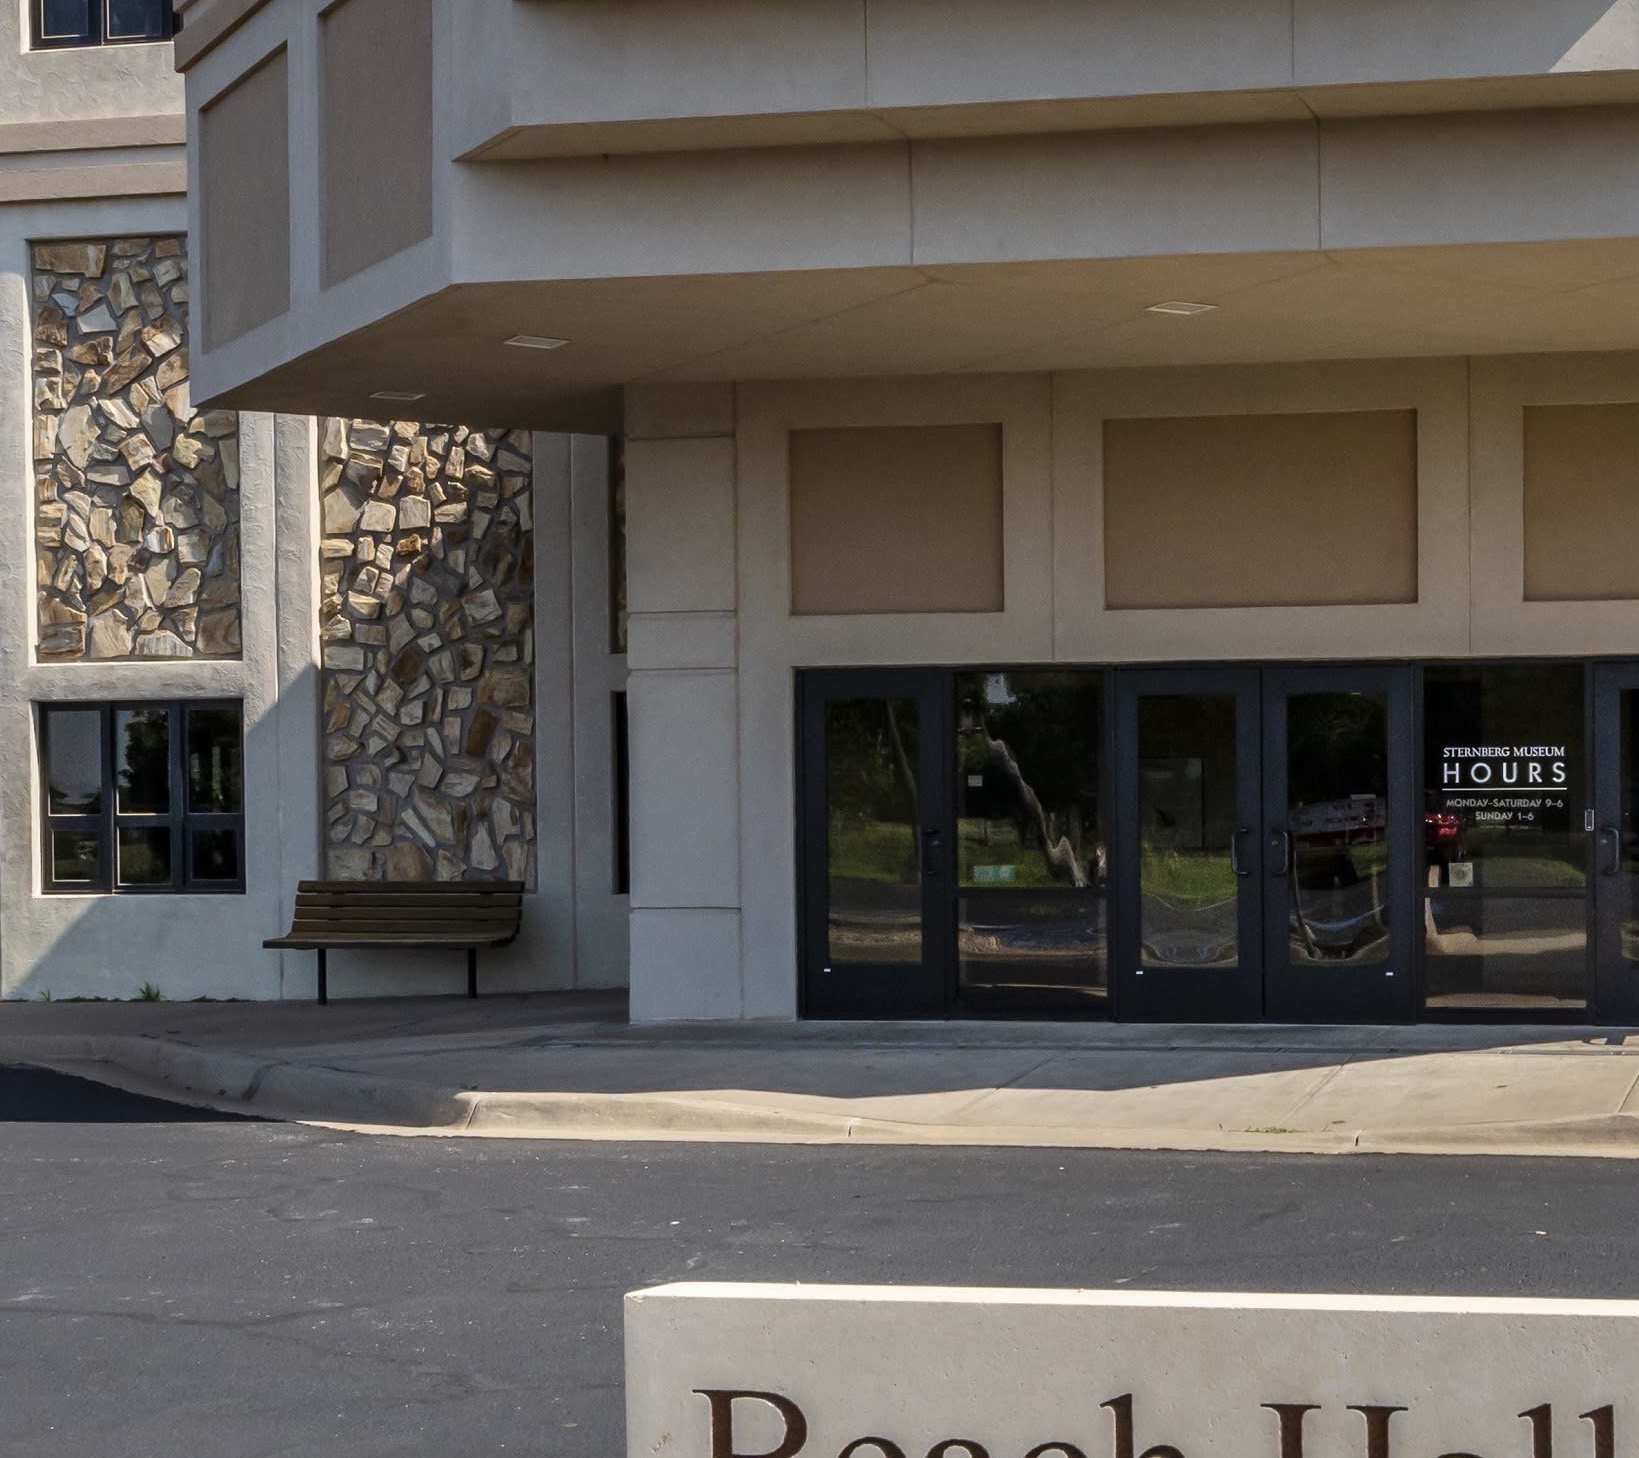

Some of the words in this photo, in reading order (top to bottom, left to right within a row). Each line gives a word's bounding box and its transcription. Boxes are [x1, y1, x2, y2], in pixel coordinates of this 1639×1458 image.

[1443, 746, 1510, 757] STERNBERG
[1513, 746, 1565, 757] MUSEUM
[1443, 762, 1566, 783] HOURS
[1475, 811, 1513, 820] SUNDAY
